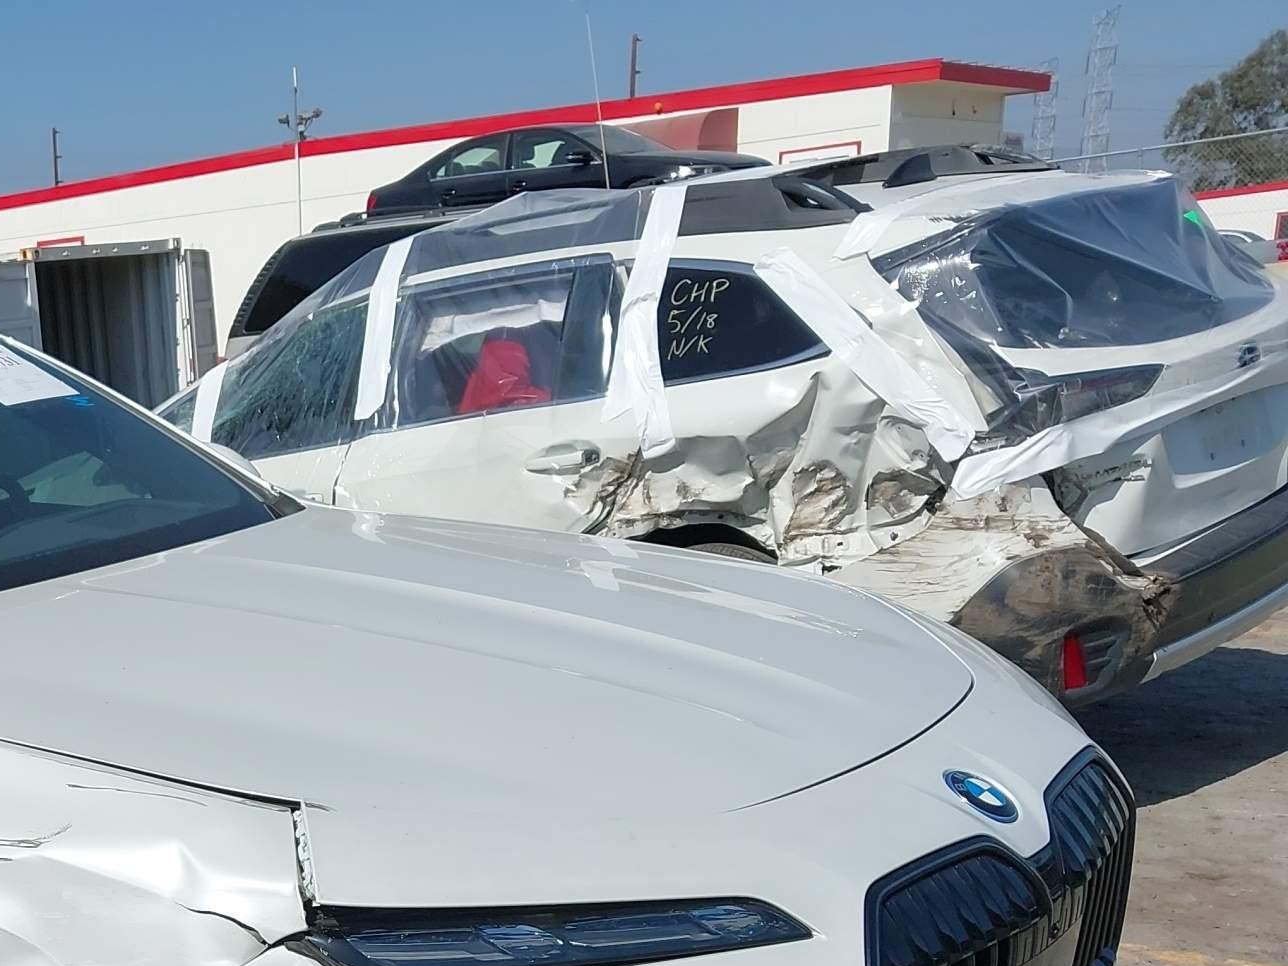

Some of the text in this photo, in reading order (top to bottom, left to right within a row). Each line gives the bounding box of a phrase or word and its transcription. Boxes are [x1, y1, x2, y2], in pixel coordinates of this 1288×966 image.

[670, 278, 730, 305] CHP
[667, 305, 719, 334] 5/18
[667, 334, 713, 361] N/K
